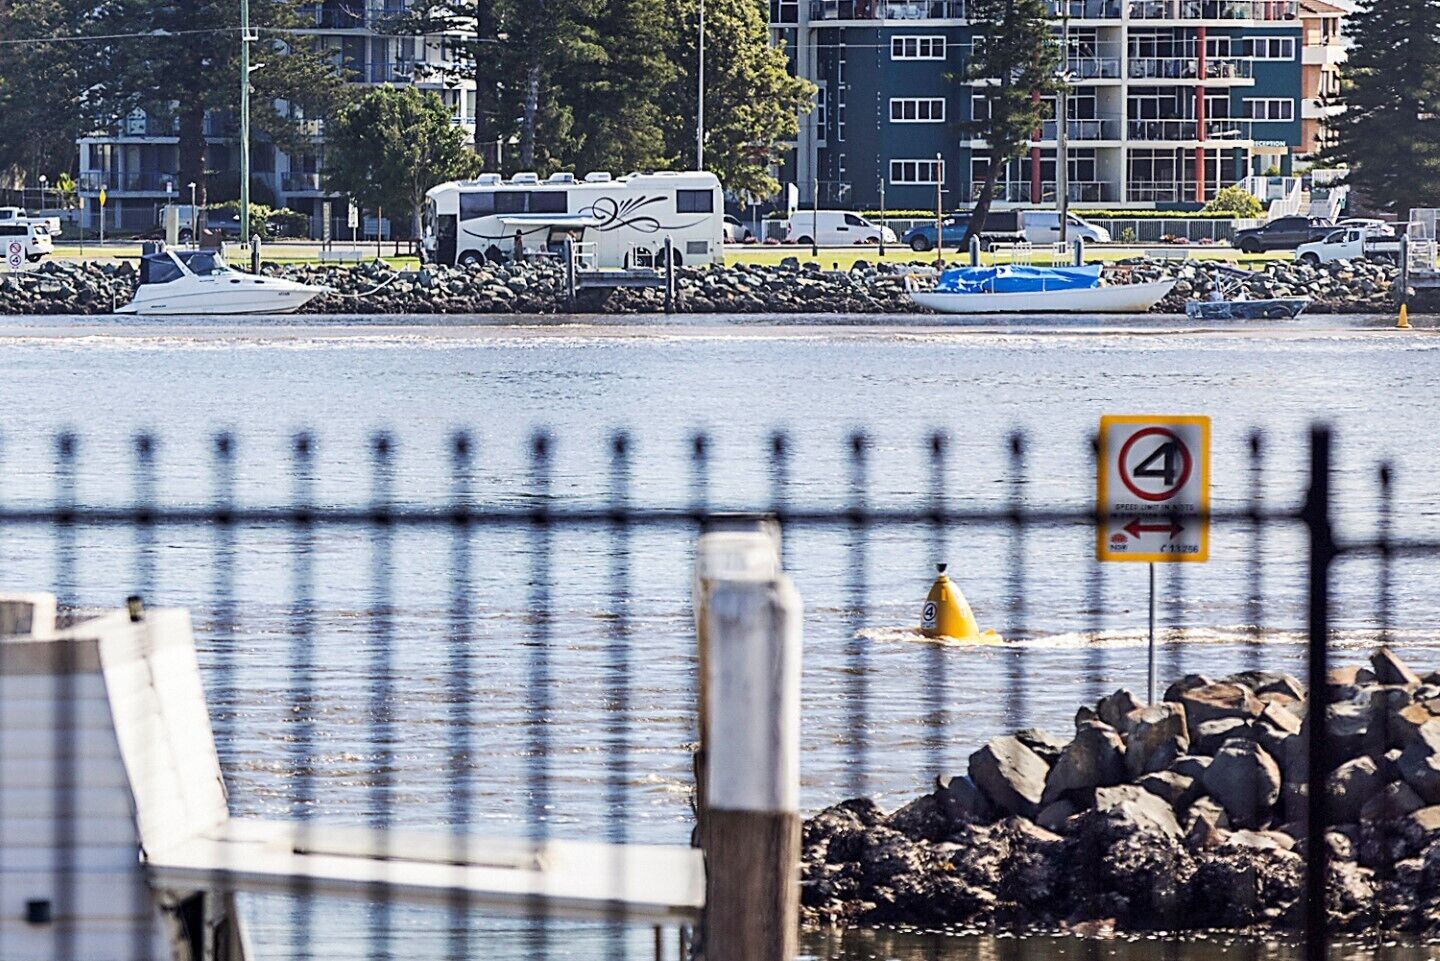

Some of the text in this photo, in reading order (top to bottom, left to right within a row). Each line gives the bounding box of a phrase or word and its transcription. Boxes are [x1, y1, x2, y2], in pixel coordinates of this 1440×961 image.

[1133, 441, 1175, 486] 4
[1114, 503, 1138, 511] SPEED
[925, 606, 934, 618] 4
